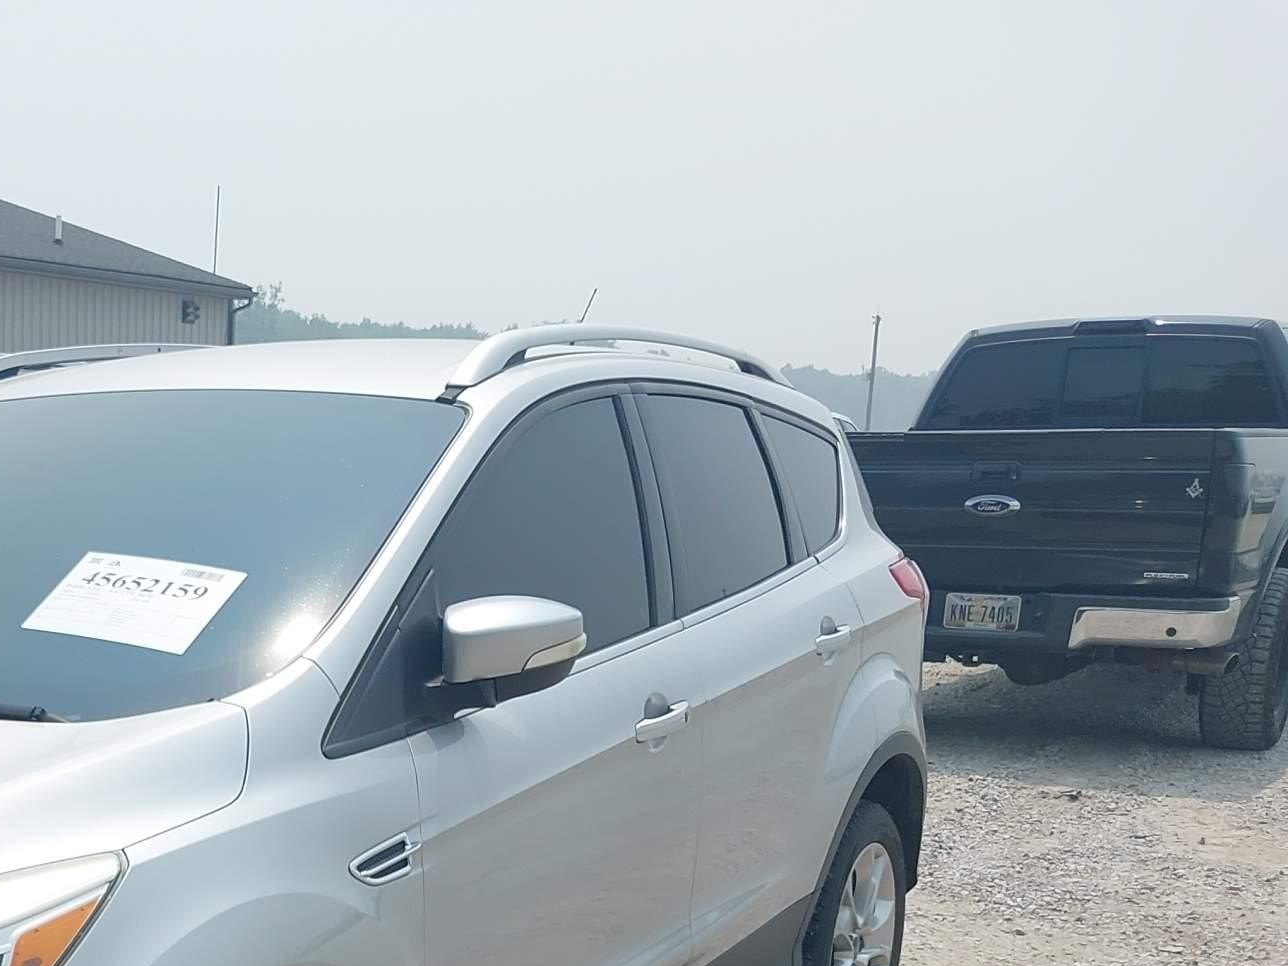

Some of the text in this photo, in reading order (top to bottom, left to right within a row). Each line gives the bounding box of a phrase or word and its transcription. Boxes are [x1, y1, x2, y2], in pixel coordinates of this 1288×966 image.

[81, 571, 209, 600] 45652159
[950, 604, 1013, 623] KNE 7405
